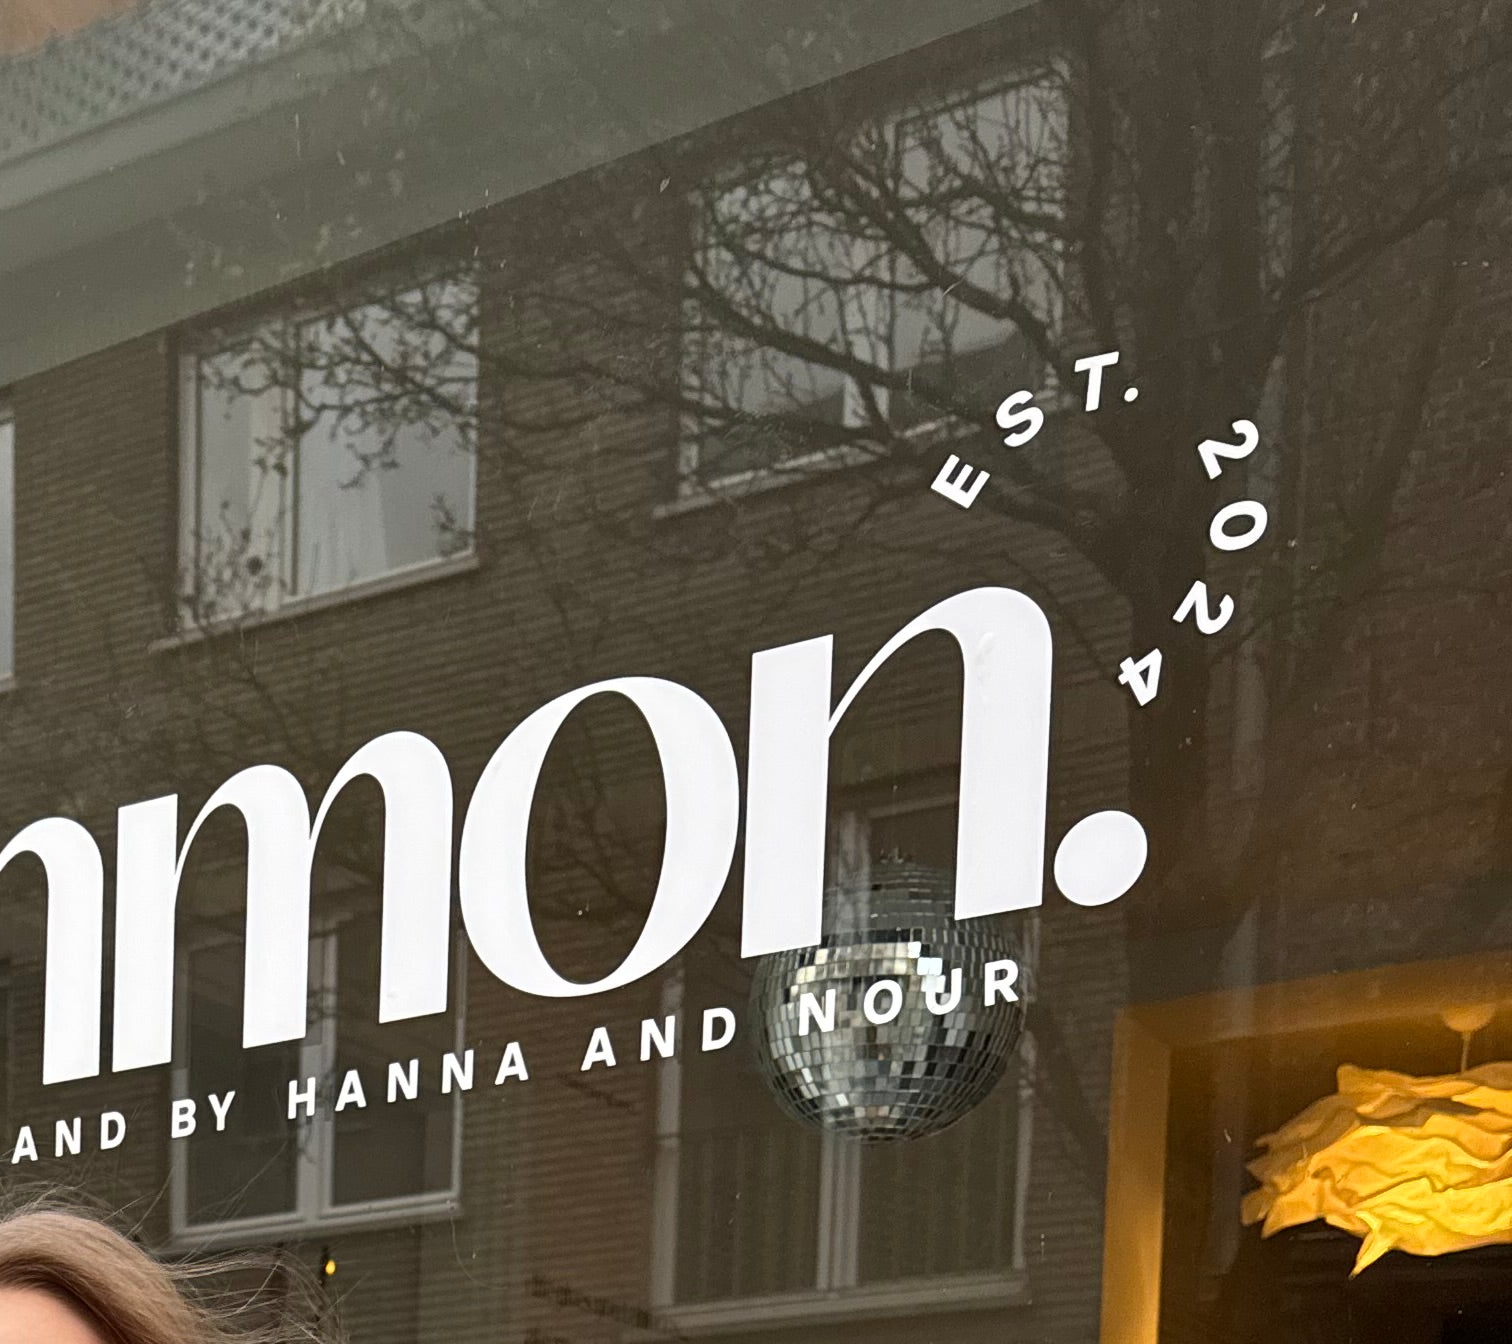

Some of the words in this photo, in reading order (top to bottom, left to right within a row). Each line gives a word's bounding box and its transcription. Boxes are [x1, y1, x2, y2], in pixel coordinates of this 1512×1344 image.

[930, 351, 1139, 509] EST.
[1118, 419, 1268, 706] 2024
[171, 1091, 237, 1139] BY
[287, 1041, 530, 1119] HANNA
[581, 1007, 737, 1071] AND
[798, 958, 1020, 1037] NOUR
